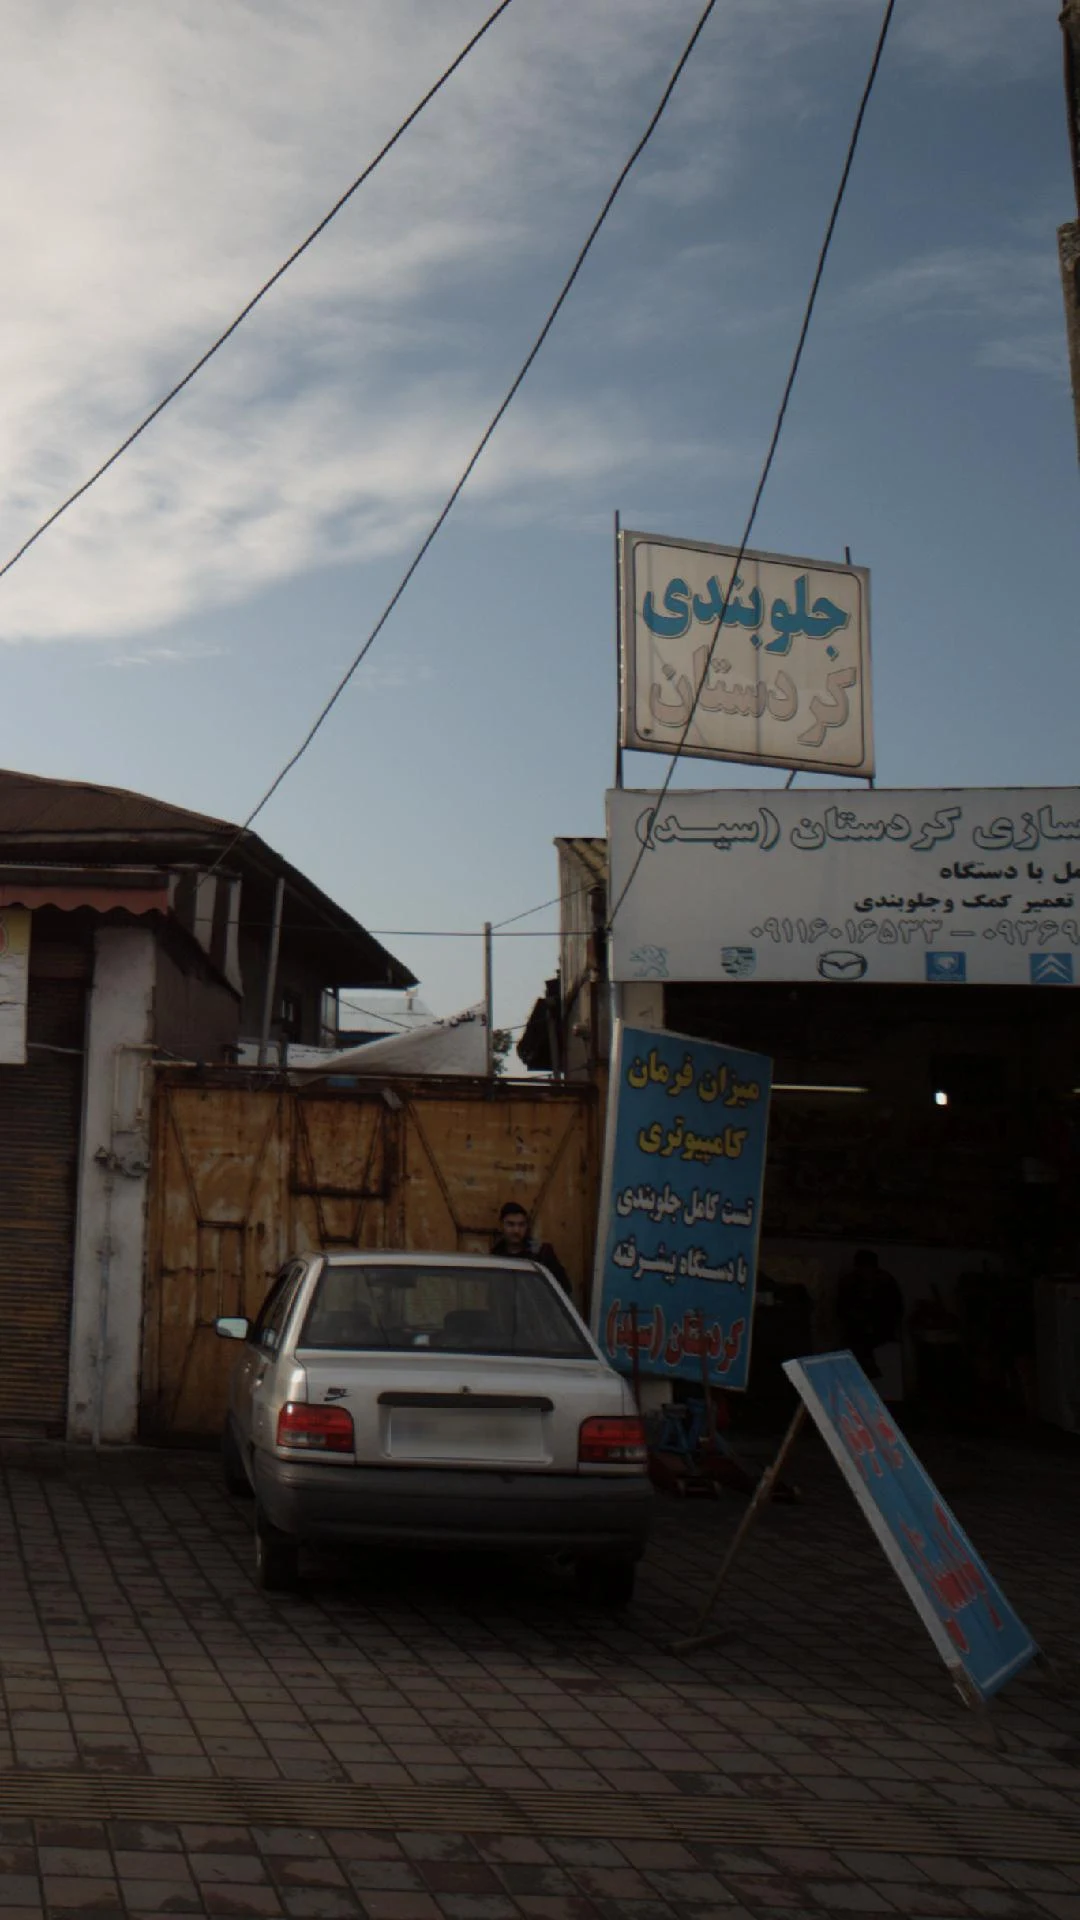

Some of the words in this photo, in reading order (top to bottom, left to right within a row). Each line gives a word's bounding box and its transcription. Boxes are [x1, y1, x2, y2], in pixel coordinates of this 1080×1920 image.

[643, 574, 851, 661] جلوبندی
[650, 645, 858, 748] کردستان
[635, 807, 781, 851] (سید)
[790, 805, 963, 851] کردستان
[940, 862, 1018, 880] دستگاه
[1027, 862, 1044, 884] با
[962, 894, 1013, 909] کمک
[1021, 892, 1075, 914] تعمیر
[627, 1048, 694, 1097] فرمان
[697, 1062, 760, 1108] میزان
[637, 1115, 749, 1166] کامپیوتری
[616, 1182, 683, 1224] جلوبندی
[683, 1186, 721, 1225] کامل
[721, 1197, 754, 1228] تست
[680, 1244, 735, 1284] دستگاه
[737, 1252, 749, 1292] با
